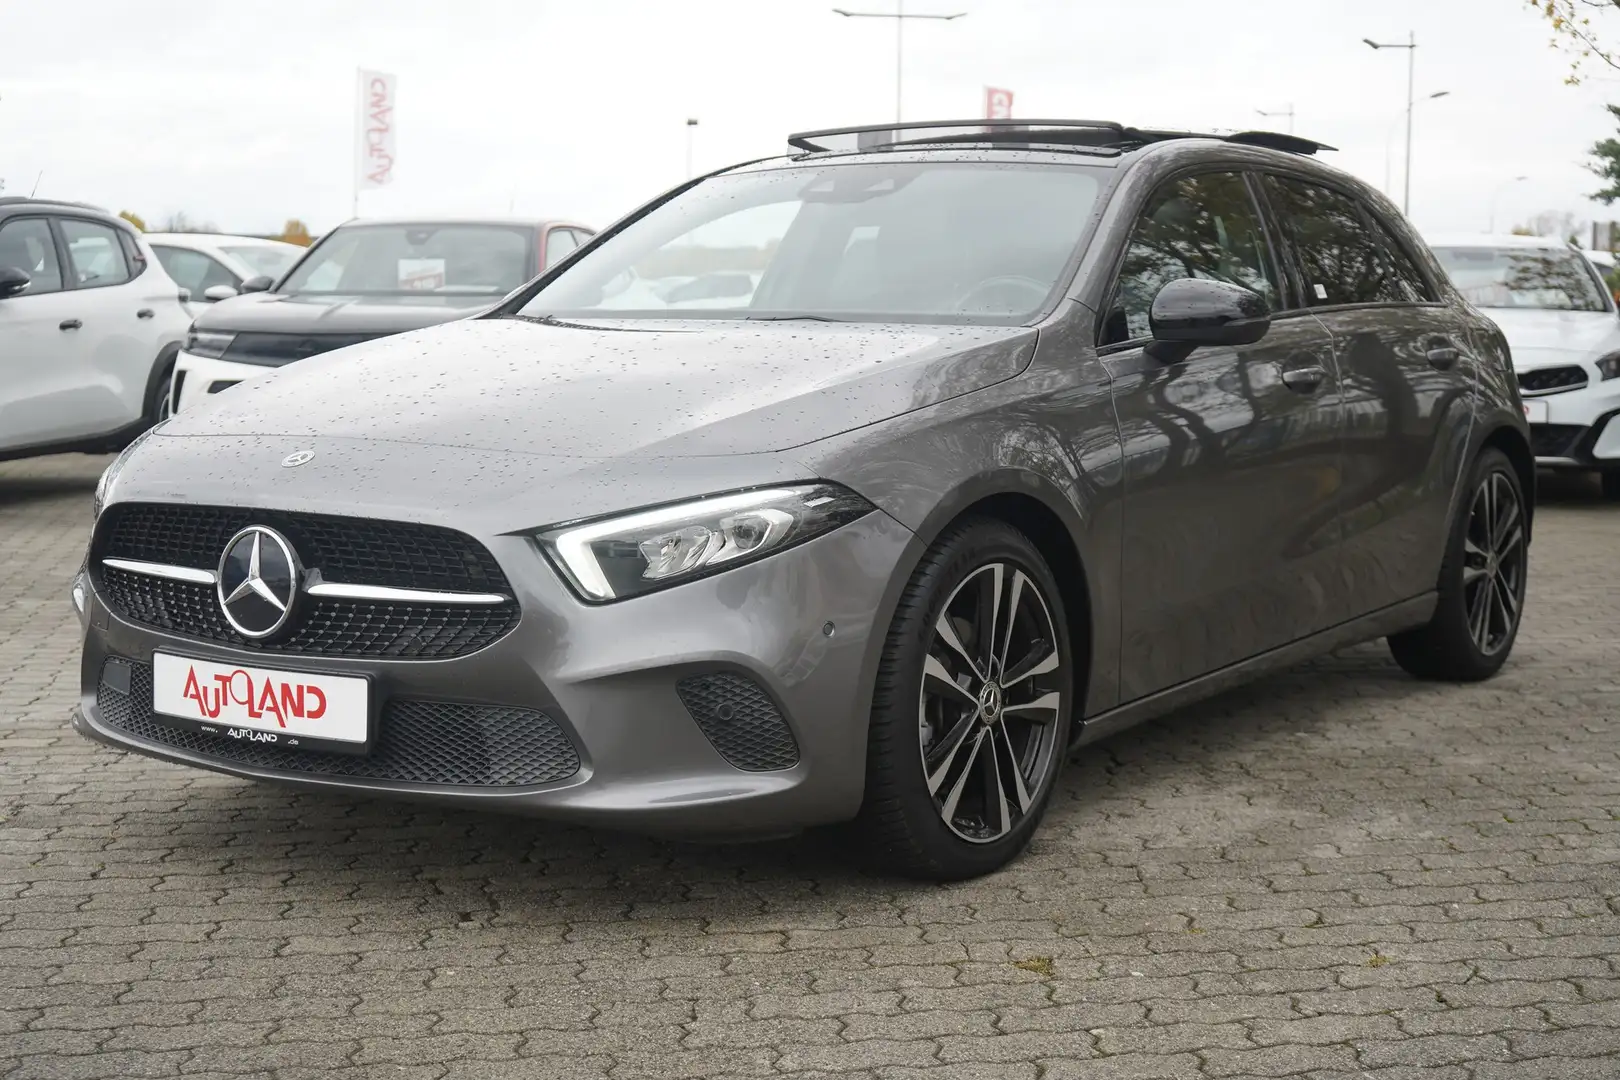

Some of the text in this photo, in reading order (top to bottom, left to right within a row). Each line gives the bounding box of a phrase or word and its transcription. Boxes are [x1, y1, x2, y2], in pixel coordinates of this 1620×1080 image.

[183, 664, 327, 728] AUTOLAND
[200, 725, 218, 733] www.
[227, 727, 278, 743] AUTOLAND
